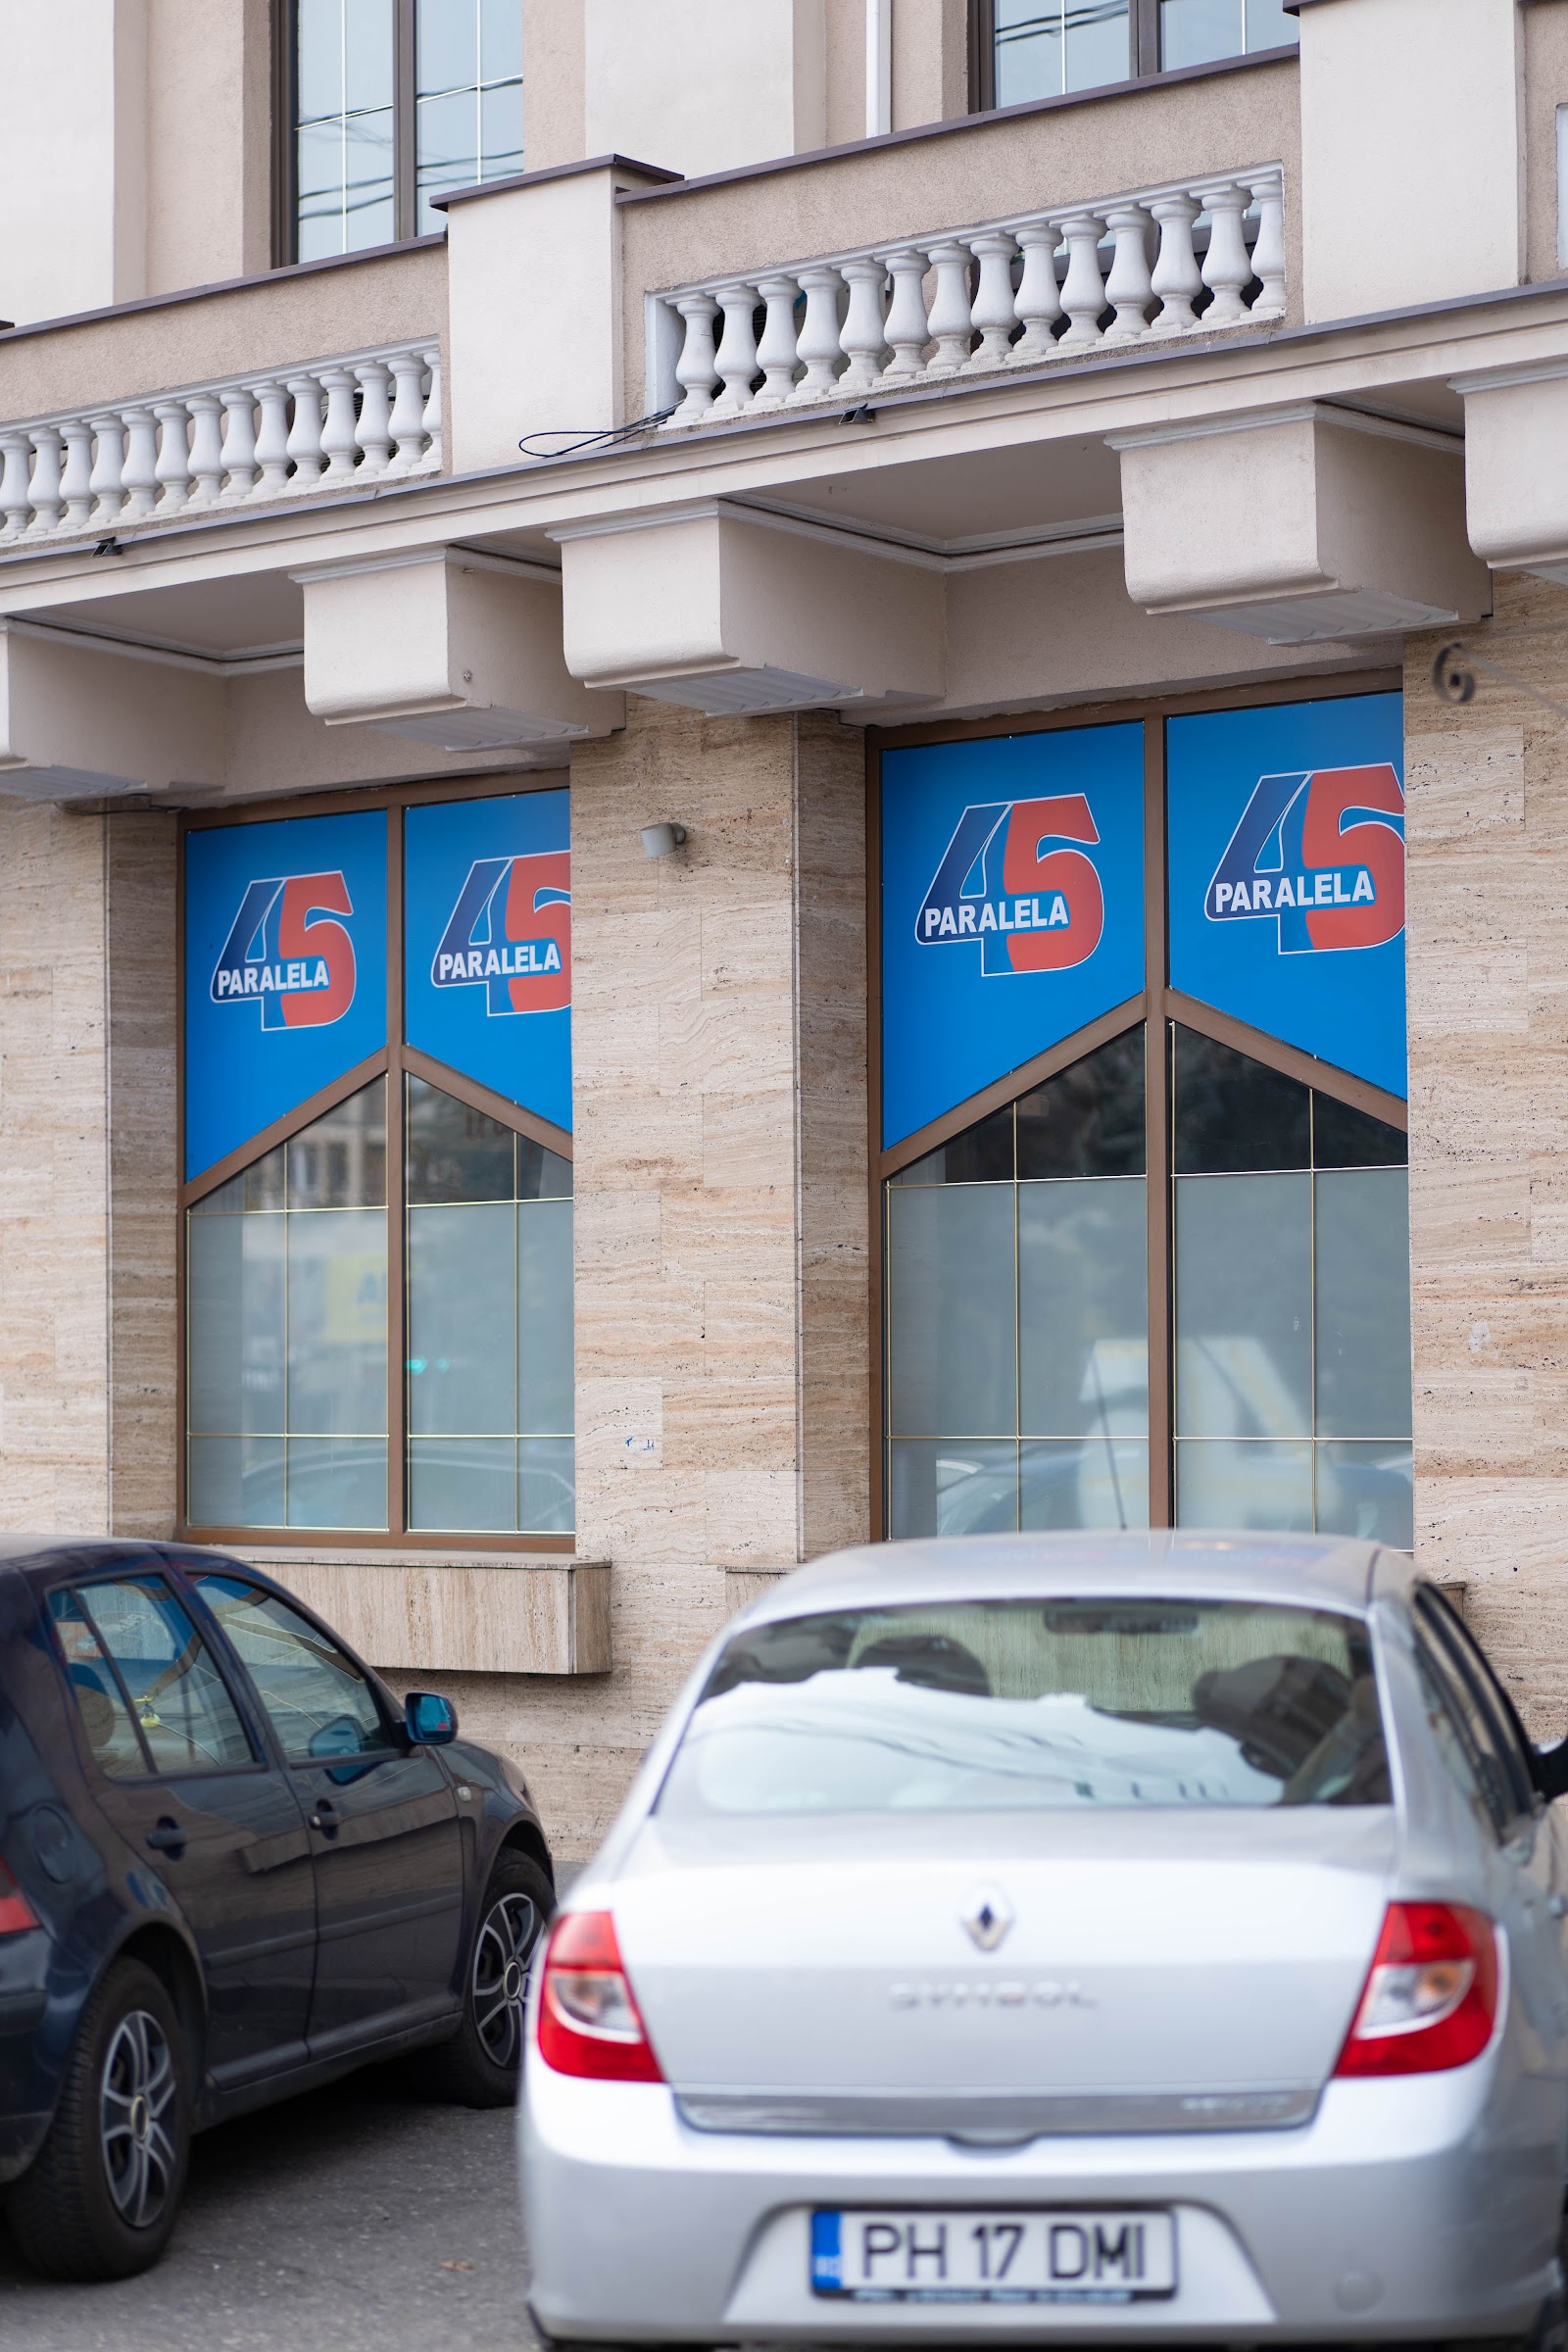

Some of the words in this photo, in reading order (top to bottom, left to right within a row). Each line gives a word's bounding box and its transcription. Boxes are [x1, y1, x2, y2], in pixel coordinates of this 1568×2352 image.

[1204, 762, 1404, 955] 45
[915, 793, 1104, 976] 45
[1215, 870, 1374, 912] PARALELA
[924, 896, 1068, 937] PARALELA
[211, 871, 356, 1031] 45
[438, 943, 561, 981] PARALELA
[218, 960, 329, 997] PARALELA
[862, 2223, 947, 2279] PH
[970, 2224, 1026, 2279] 17
[1049, 2223, 1145, 2280] DMI
